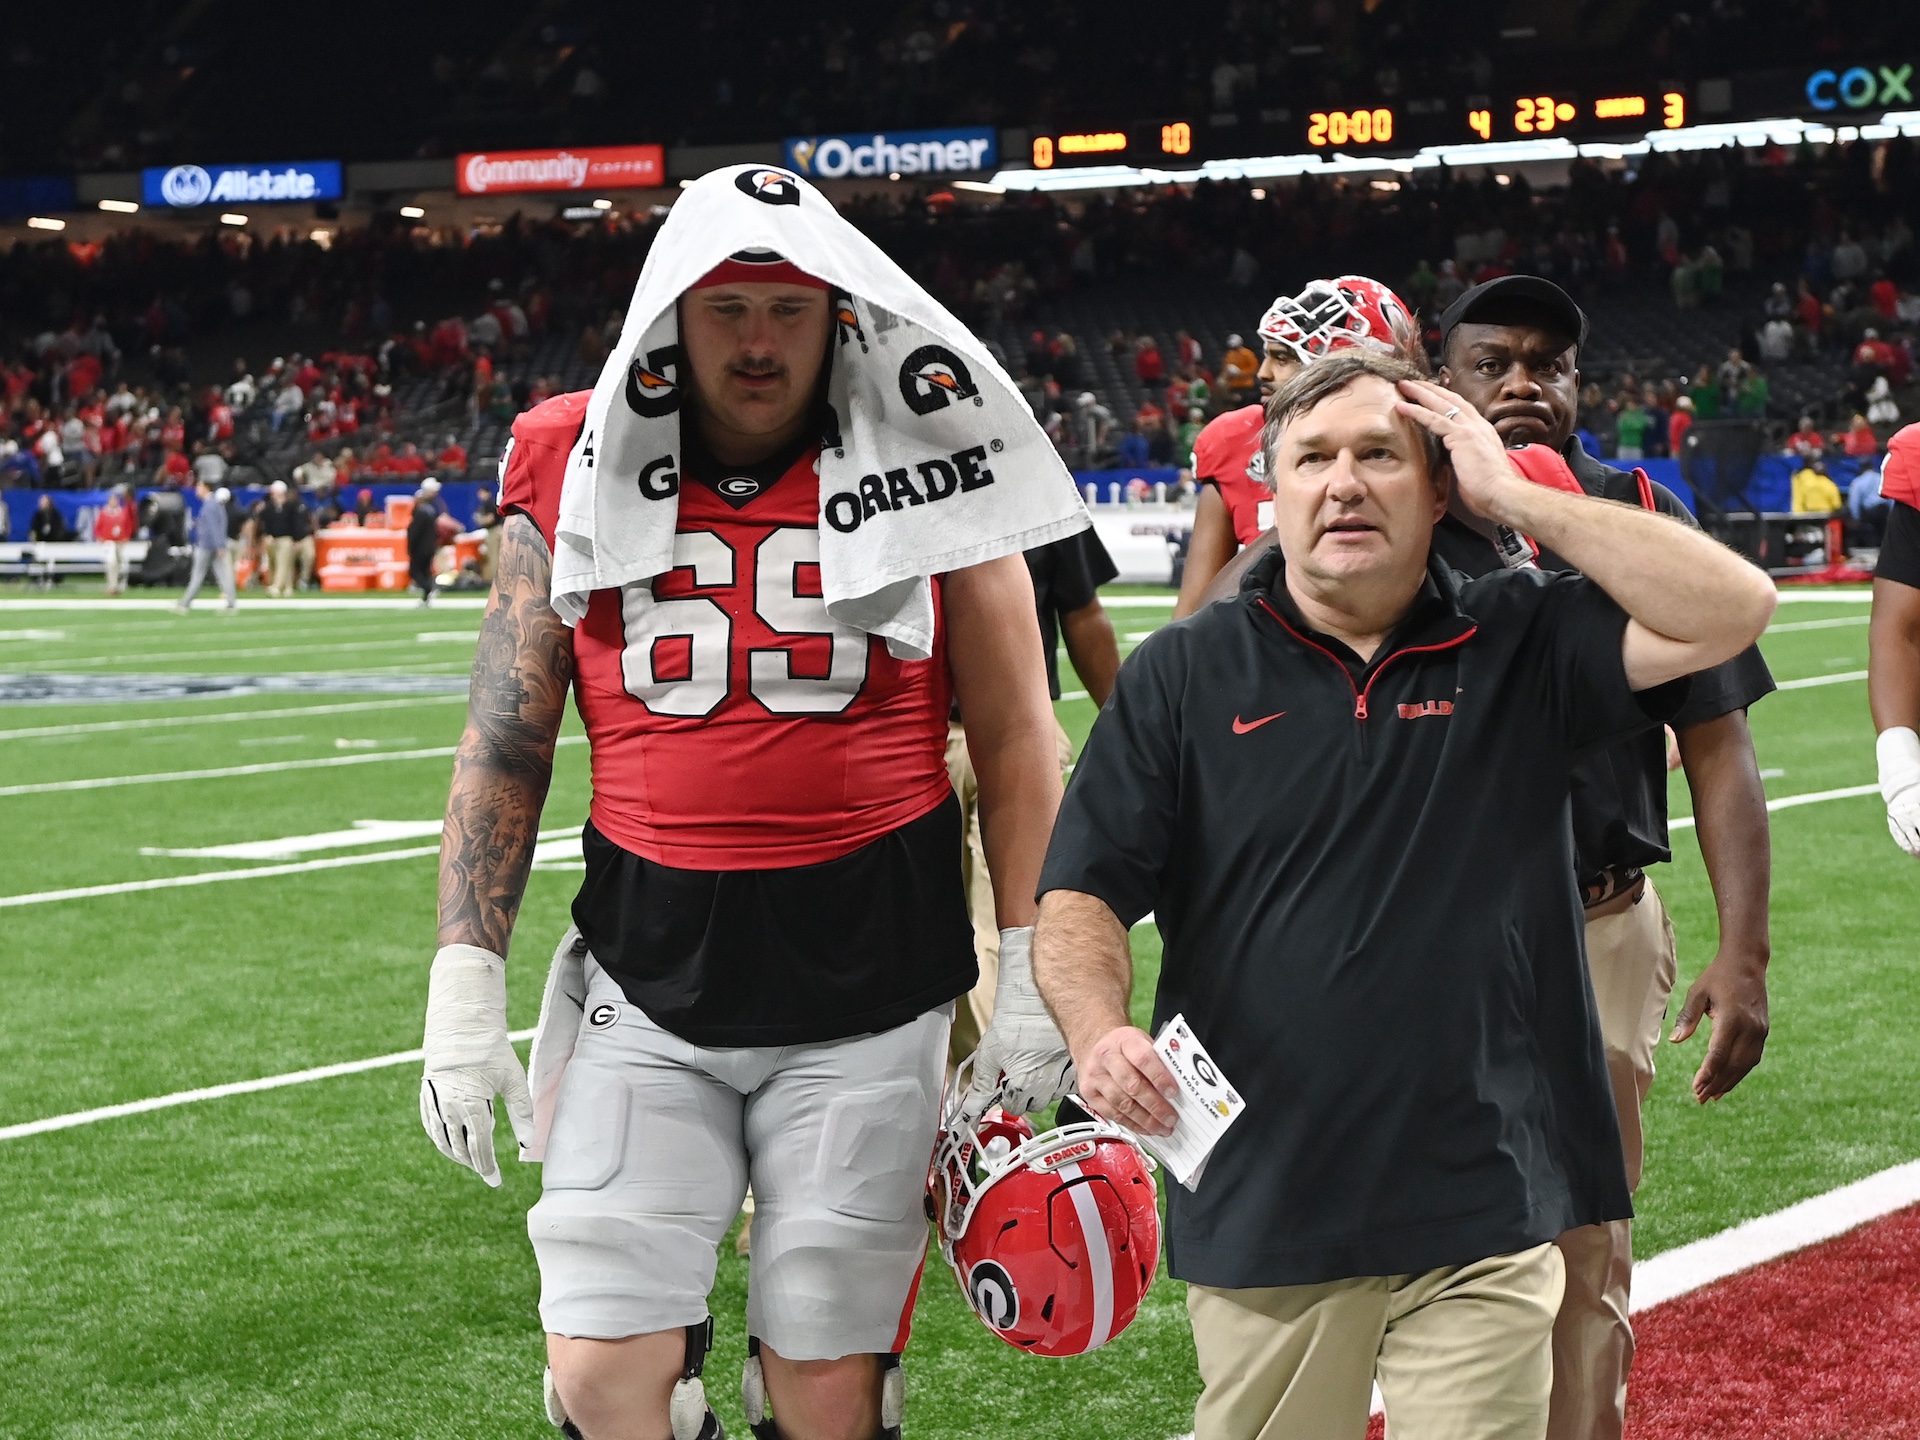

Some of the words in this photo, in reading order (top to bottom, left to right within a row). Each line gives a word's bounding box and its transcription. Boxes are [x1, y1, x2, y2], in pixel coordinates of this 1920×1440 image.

[1806, 64, 1913, 111] COX
[1308, 108, 1392, 146] 20:00
[1469, 110, 1491, 140] 4
[1514, 97, 1555, 133] 23
[1663, 92, 1684, 129] 3
[465, 151, 589, 192] Community
[815, 134, 989, 178] Ochsner
[210, 168, 316, 202] Allstate
[622, 526, 869, 718] 69
[1164, 1048, 1182, 1075] MEDIA
[1183, 1075, 1199, 1096] POST
[1200, 1098, 1219, 1120] GAME
[1043, 1142, 1091, 1167] DAWGS
